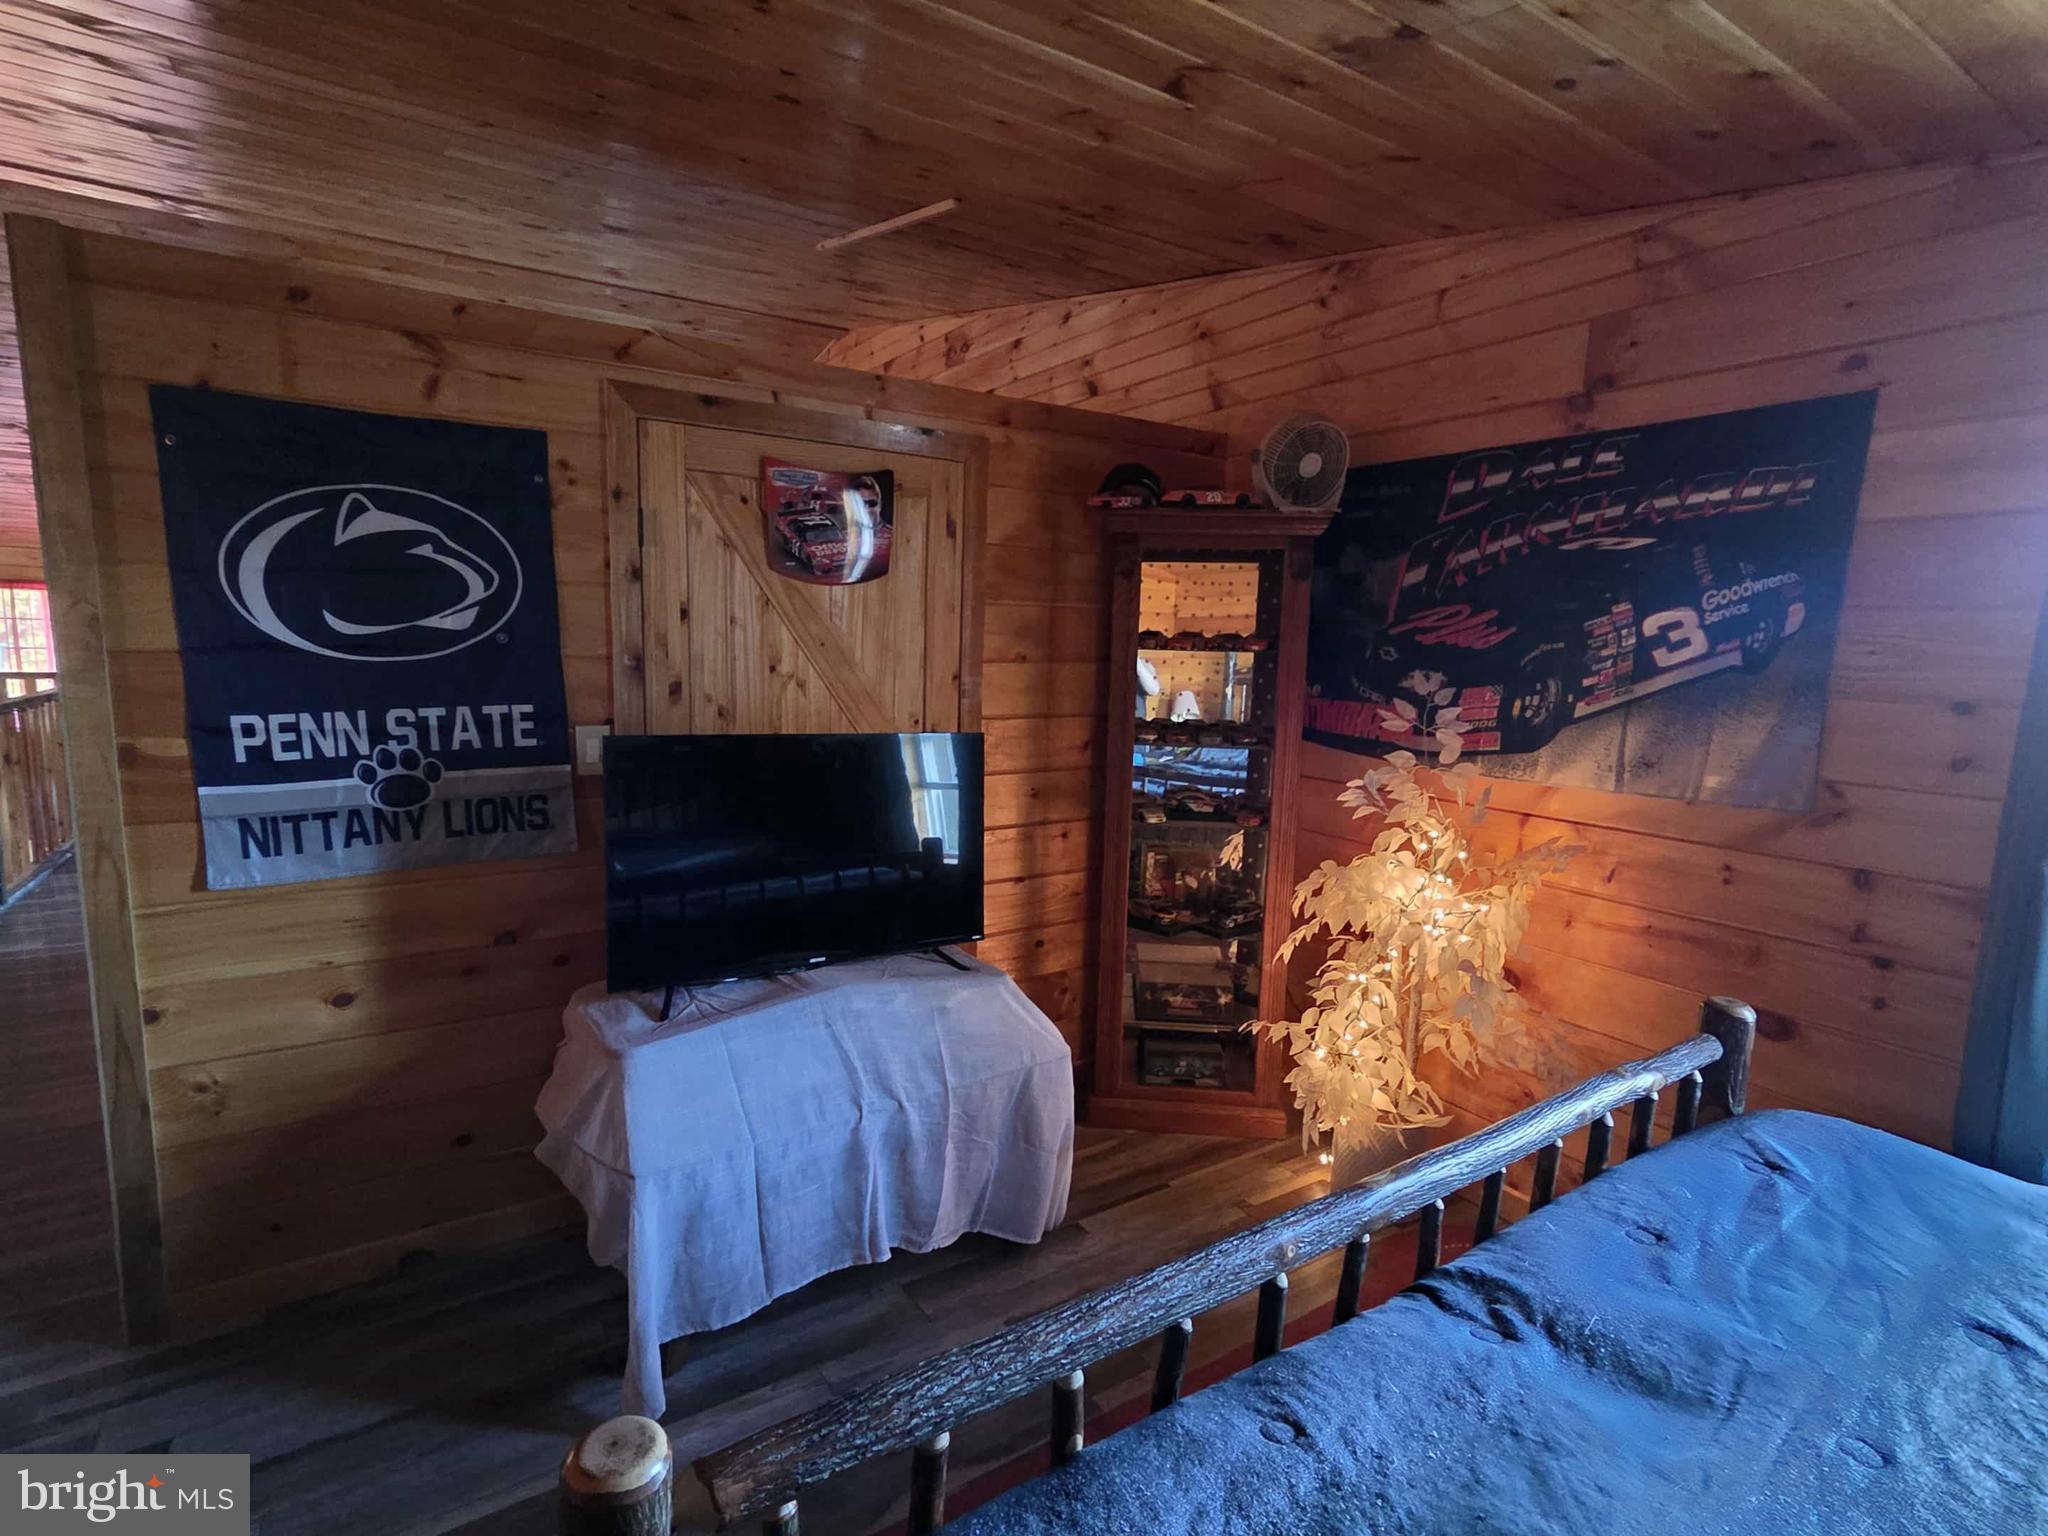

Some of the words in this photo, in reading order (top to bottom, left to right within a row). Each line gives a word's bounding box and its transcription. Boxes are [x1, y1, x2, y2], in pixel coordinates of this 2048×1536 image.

[1701, 571, 1802, 611] Goodwrench
[1703, 603, 1751, 625] Service
[1642, 606, 1709, 668] 3
[229, 710, 370, 763] PENN
[385, 704, 538, 751] STATE
[238, 807, 426, 860] NITTANY
[443, 794, 551, 839] LIONS
